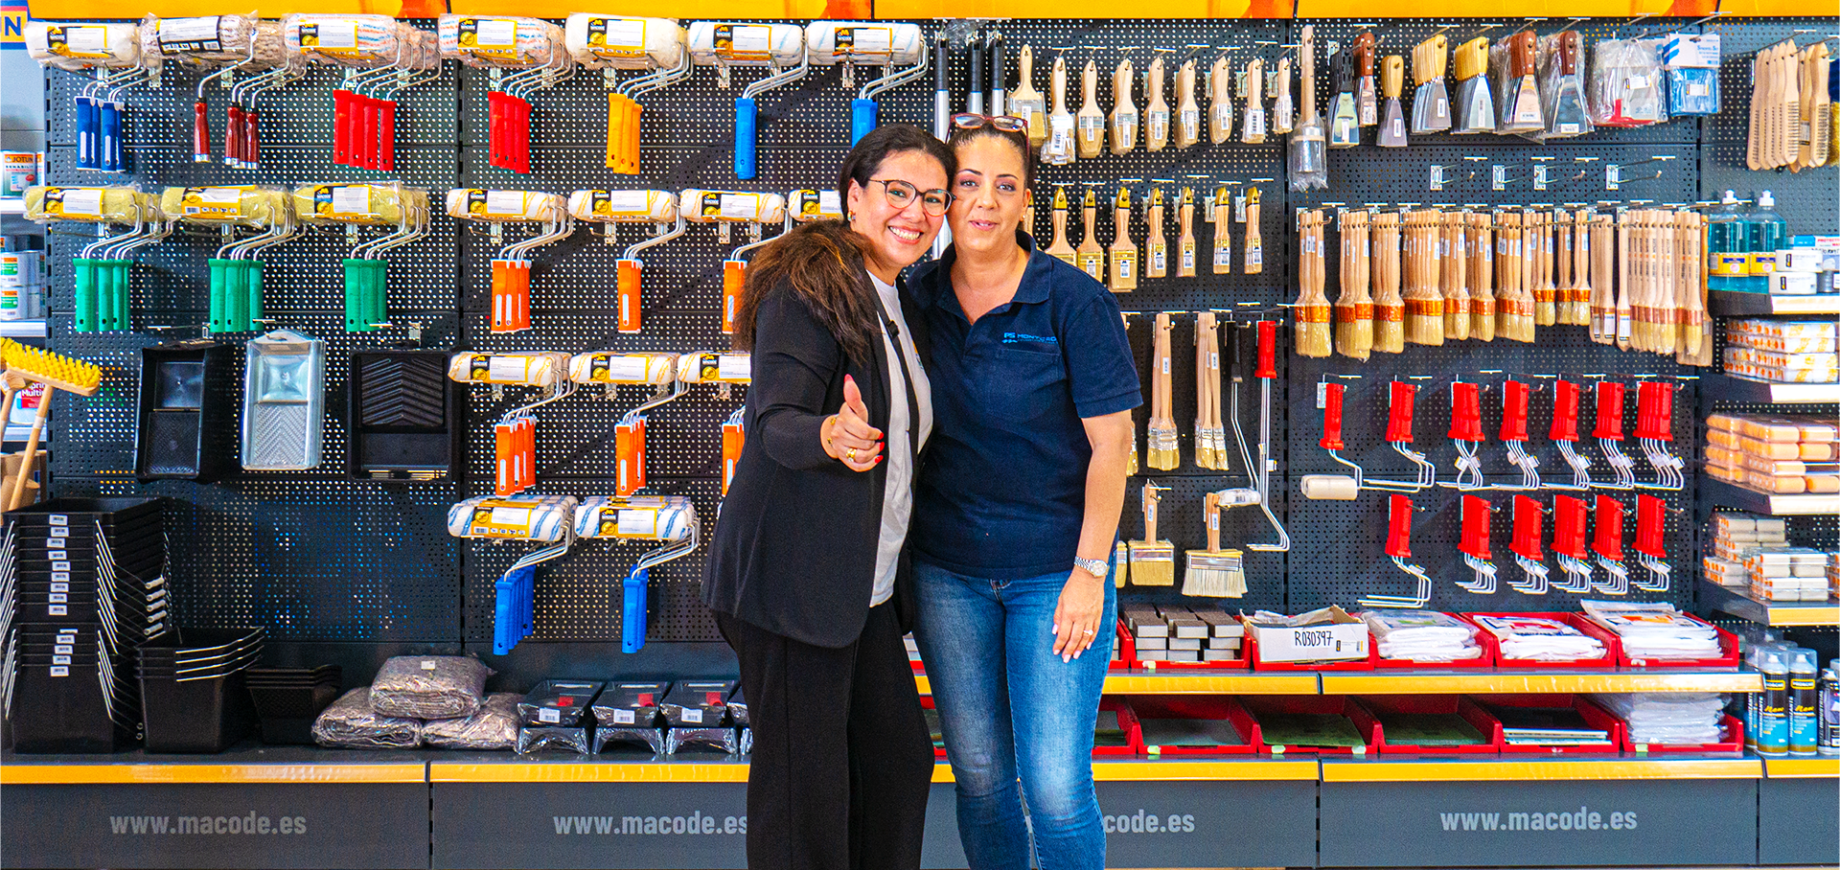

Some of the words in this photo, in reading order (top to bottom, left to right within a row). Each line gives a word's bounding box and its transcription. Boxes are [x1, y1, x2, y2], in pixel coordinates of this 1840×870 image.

[3, 16, 22, 37] N
[1294, 630, 1333, 647] R030397
[109, 810, 307, 835] www.macode.es
[553, 810, 747, 835] www.macode.es
[1103, 808, 1195, 834] code.es
[1440, 806, 1638, 831] www.macode.es
